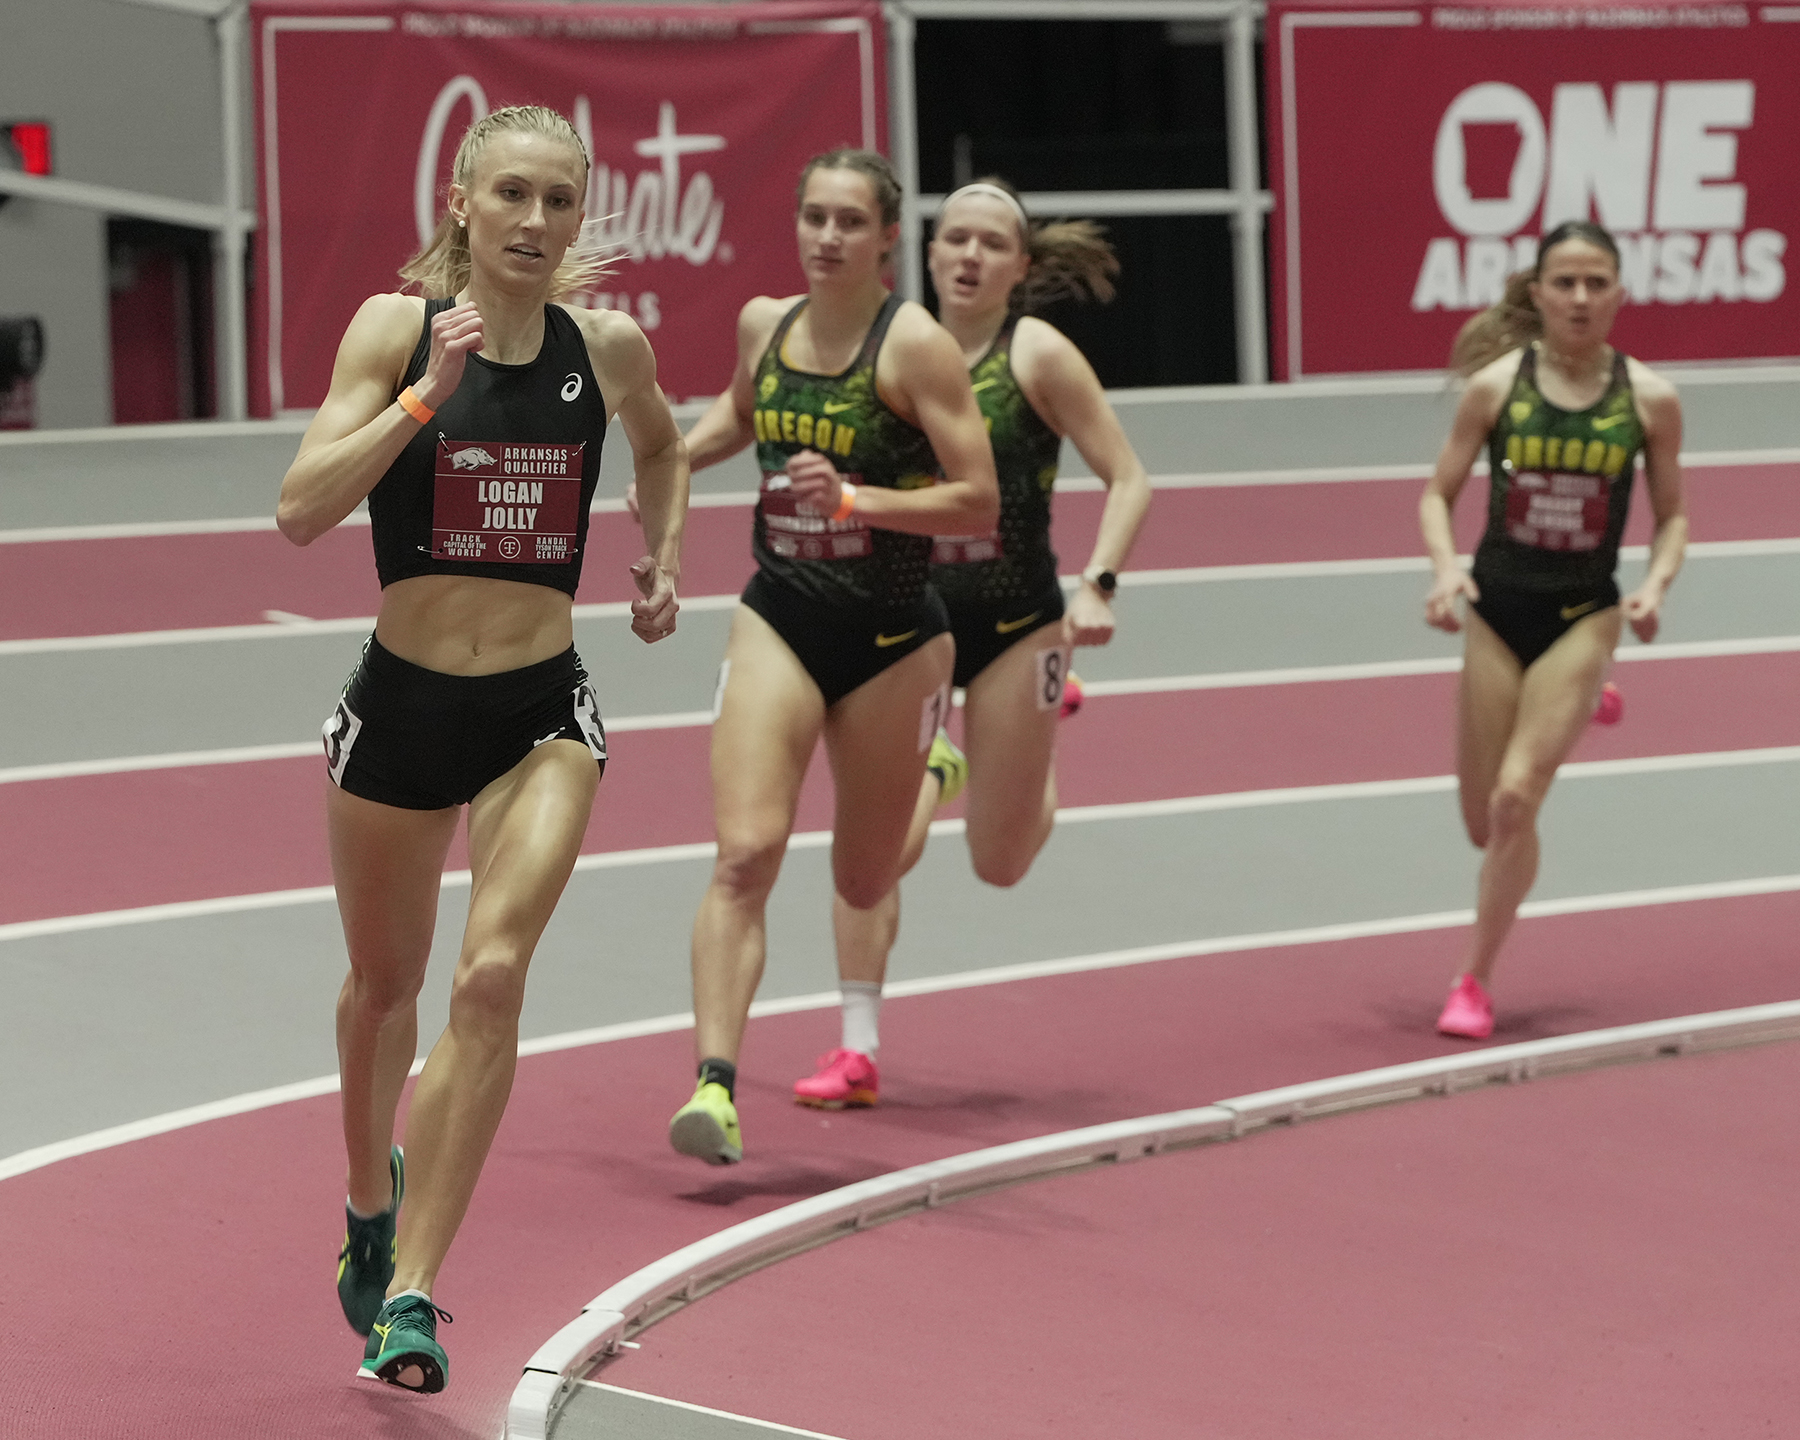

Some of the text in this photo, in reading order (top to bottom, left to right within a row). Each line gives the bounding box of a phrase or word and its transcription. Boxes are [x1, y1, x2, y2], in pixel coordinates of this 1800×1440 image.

[1433, 79, 1755, 237] ONE
[504, 447, 568, 461] ARKANSAS
[504, 461, 567, 475] QUALIFIER
[478, 481, 543, 504] LOGAN
[482, 507, 538, 530] JOLLY
[443, 540, 467, 549] CAPITAL
[475, 542, 487, 550] THE
[450, 533, 481, 543] TRACK
[536, 536, 567, 545] RANDAL
[448, 547, 481, 557] WORLD
[536, 550, 566, 560] CENTER
[1044, 651, 1061, 704] 8
[577, 684, 606, 754] 3
